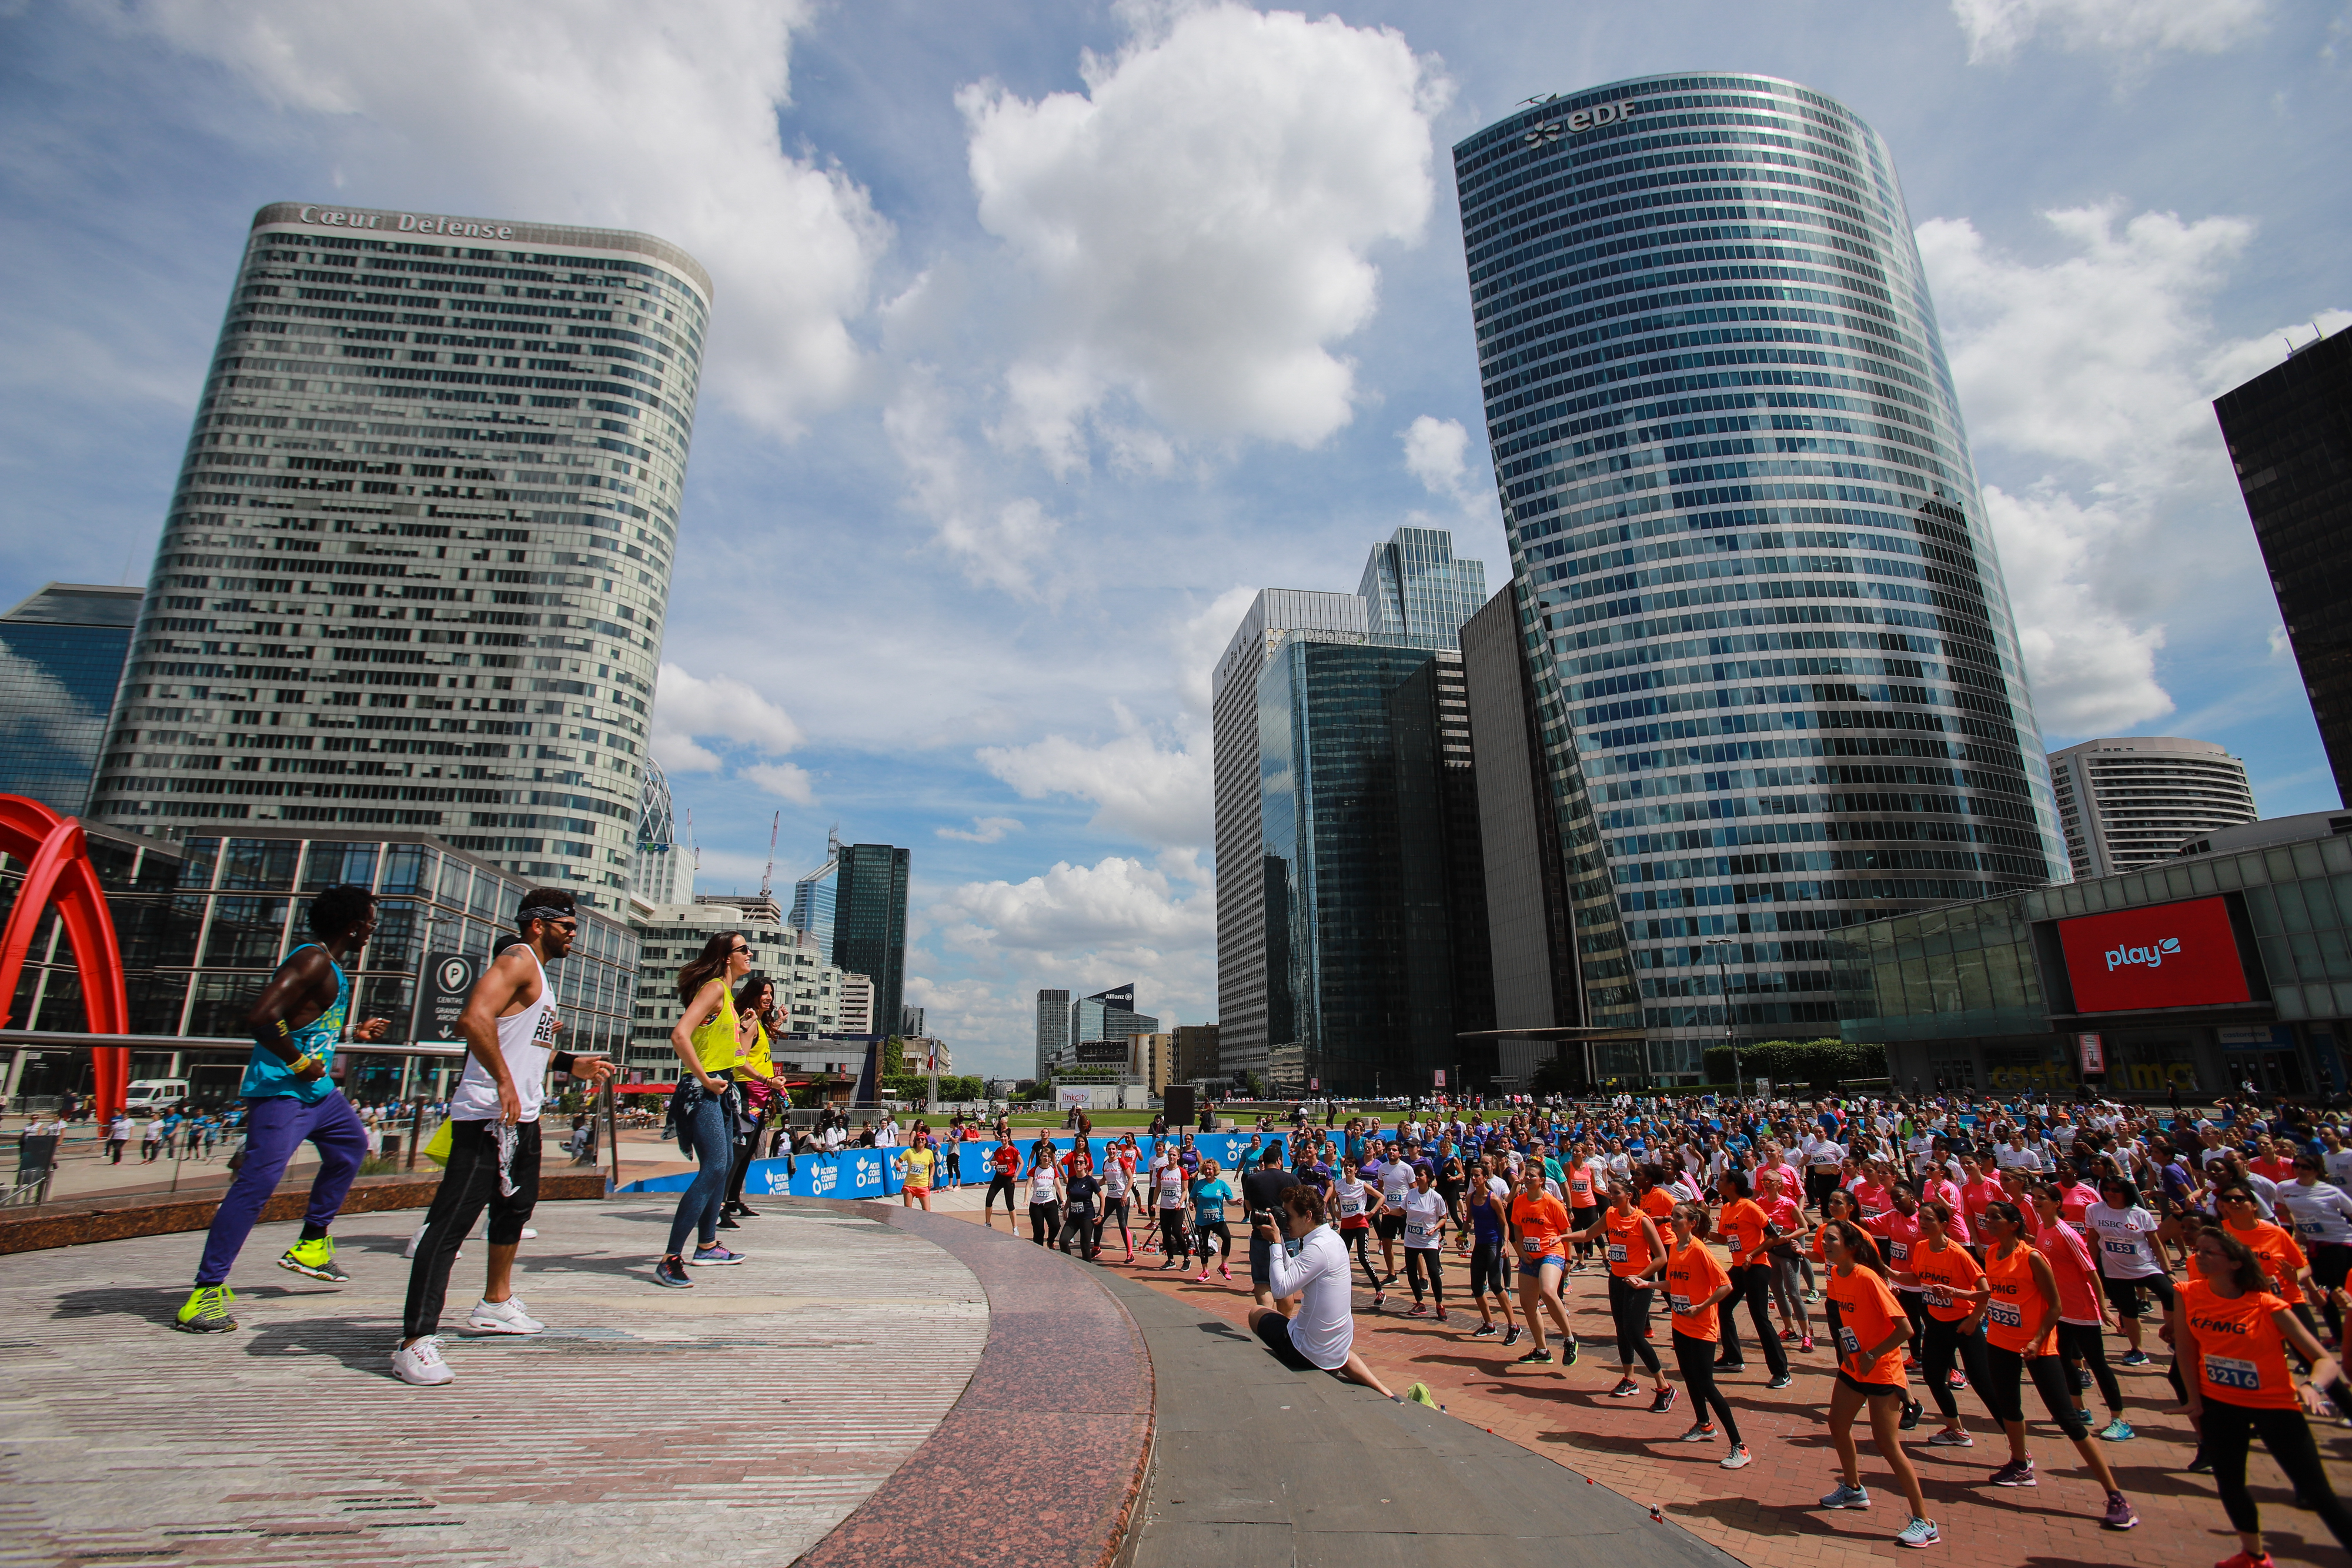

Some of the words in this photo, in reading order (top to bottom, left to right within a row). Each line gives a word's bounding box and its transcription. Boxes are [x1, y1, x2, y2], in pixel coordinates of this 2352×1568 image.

[300, 206, 380, 229] Cœur
[398, 213, 513, 240] Défense
[2104, 944, 2161, 971] play
[452, 968, 459, 978] P
[2321, 1055, 2330, 1065] 2
[1063, 1092, 1089, 1102] linkcity
[820, 1166, 838, 1175] ACTION
[774, 1172, 789, 1182] ACTION
[821, 1174, 838, 1183] CONTRE
[822, 1182, 828, 1191] LA
[2098, 1220, 2123, 1229] HSBC
[1524, 1243, 1541, 1251] 3122
[2109, 1243, 2131, 1253] 153
[1609, 1252, 1626, 1261] 3884
[1919, 1271, 1950, 1284] KPMG
[1987, 1308, 2019, 1325] 3329
[2190, 1316, 2246, 1334] KPMG
[2207, 1366, 2257, 1388] 3216
